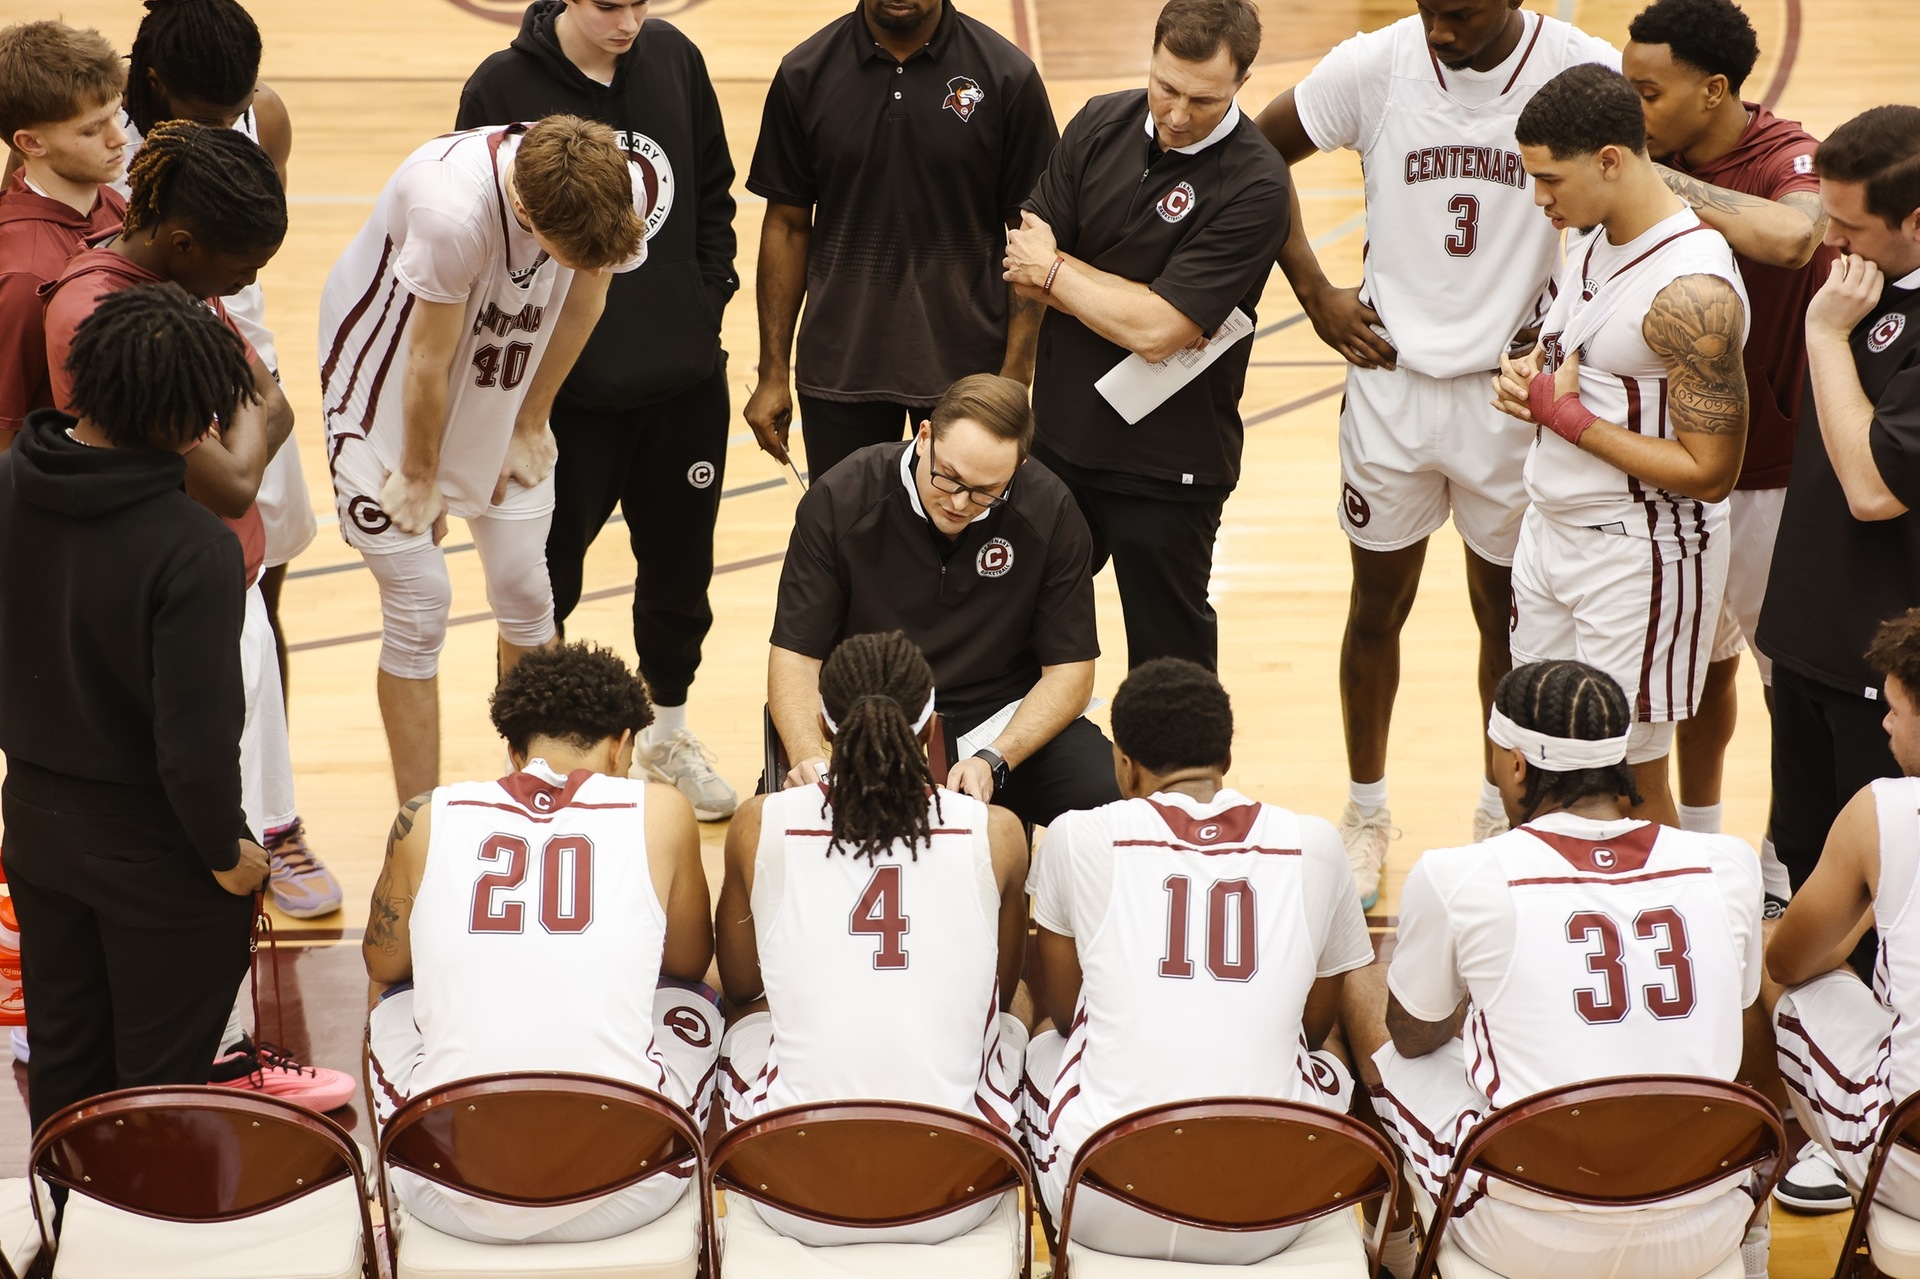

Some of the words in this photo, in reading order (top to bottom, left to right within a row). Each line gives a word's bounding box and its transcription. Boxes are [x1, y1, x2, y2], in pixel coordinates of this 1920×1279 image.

[1404, 145, 1527, 189] CENTENARY
[1166, 190, 1187, 213] C
[1445, 193, 1480, 257] 3
[1875, 321, 1897, 342] C
[472, 341, 534, 391] 40
[694, 467, 709, 483] C
[353, 499, 388, 530] C
[1345, 487, 1365, 524] C
[985, 547, 1003, 568] C
[532, 791, 552, 811] C
[1199, 825, 1218, 840] C
[1594, 850, 1614, 867] C
[468, 832, 594, 934] 20
[849, 864, 910, 970] 4
[1158, 874, 1258, 983] 10
[1565, 905, 1697, 1025] 33
